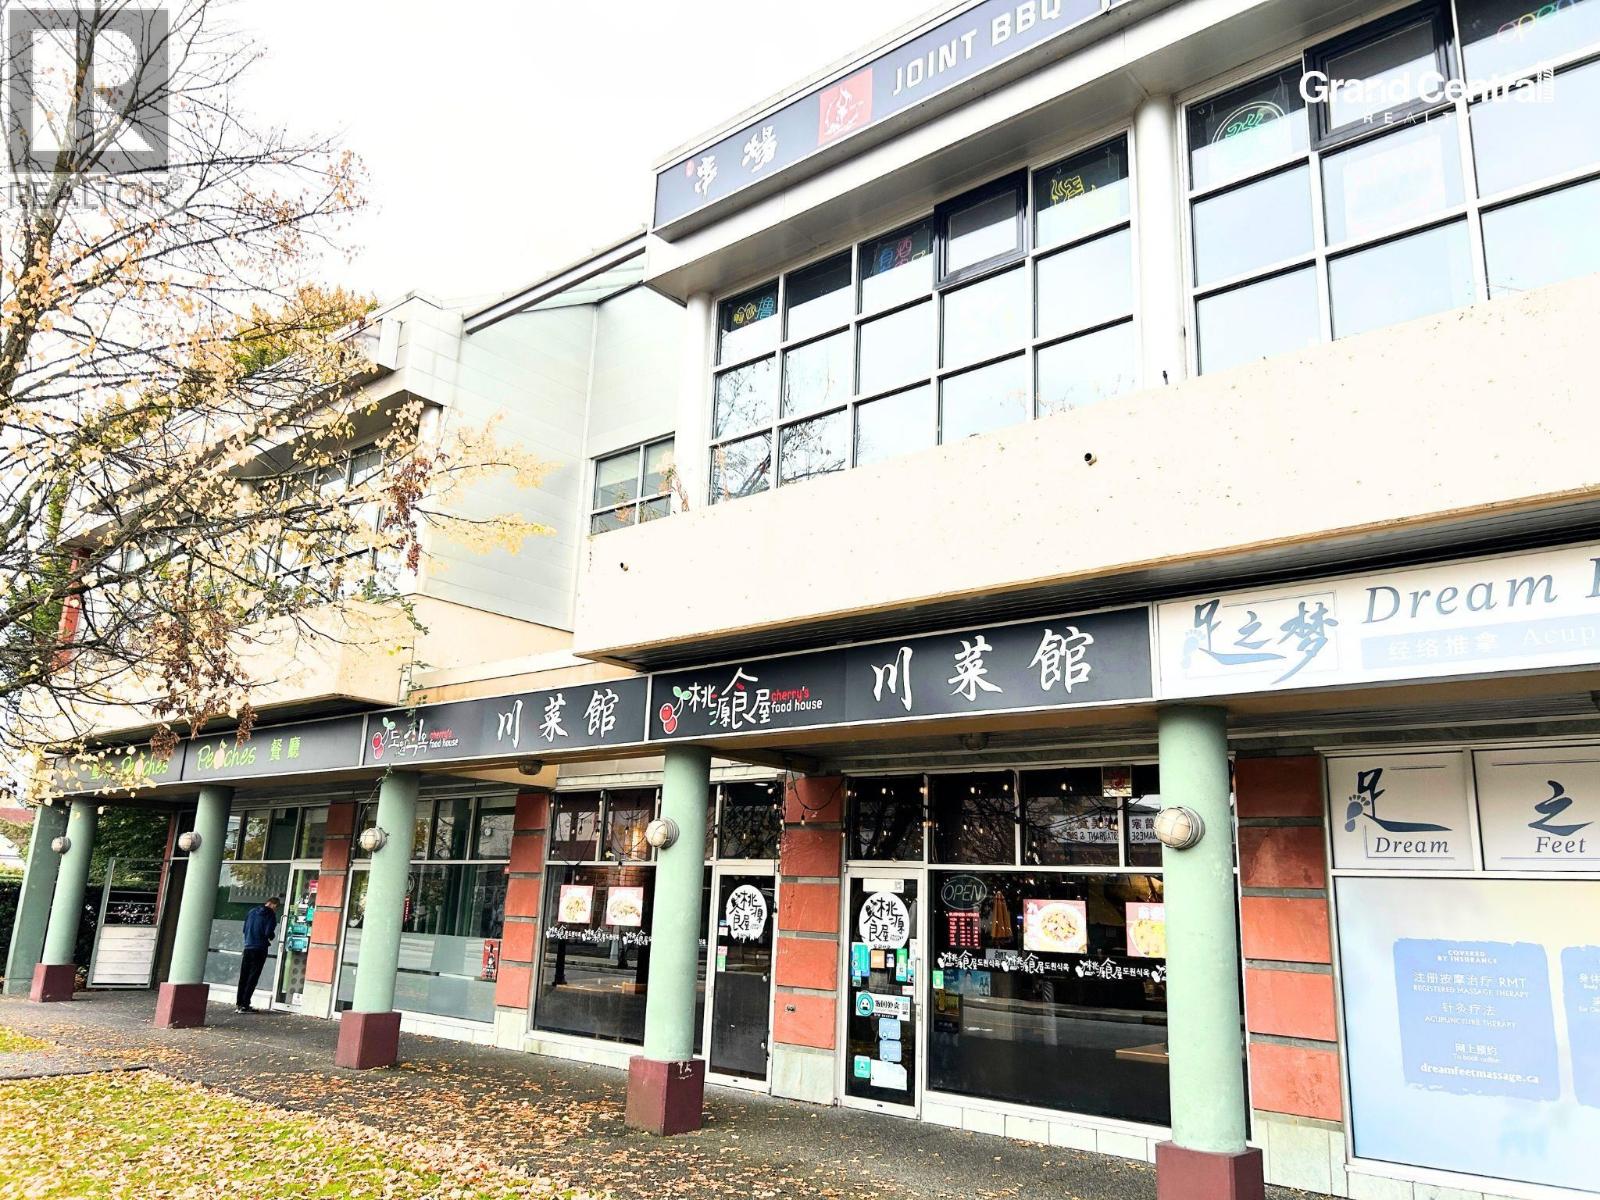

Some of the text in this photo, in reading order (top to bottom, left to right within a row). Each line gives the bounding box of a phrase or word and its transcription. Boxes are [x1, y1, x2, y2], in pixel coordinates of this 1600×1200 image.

[891, 0, 1063, 98] JOINT BBQ
[1362, 572, 1558, 625] Dream
[1188, 598, 1339, 685] 足之梦
[871, 626, 1095, 712] 川菜館
[771, 686, 810, 702] cherry's
[771, 698, 823, 713] food house
[497, 688, 619, 749] 川菜館
[429, 737, 459, 748] food house
[197, 742, 256, 770] Peaches
[1528, 780, 1594, 836] 之
[1375, 837, 1449, 853] Dream
[1536, 836, 1587, 853] Feet
[948, 885, 983, 904] OPEN
[1499, 977, 1527, 988] RMT
[1420, 1063, 1539, 1084] dreamfeetmassage.ca
